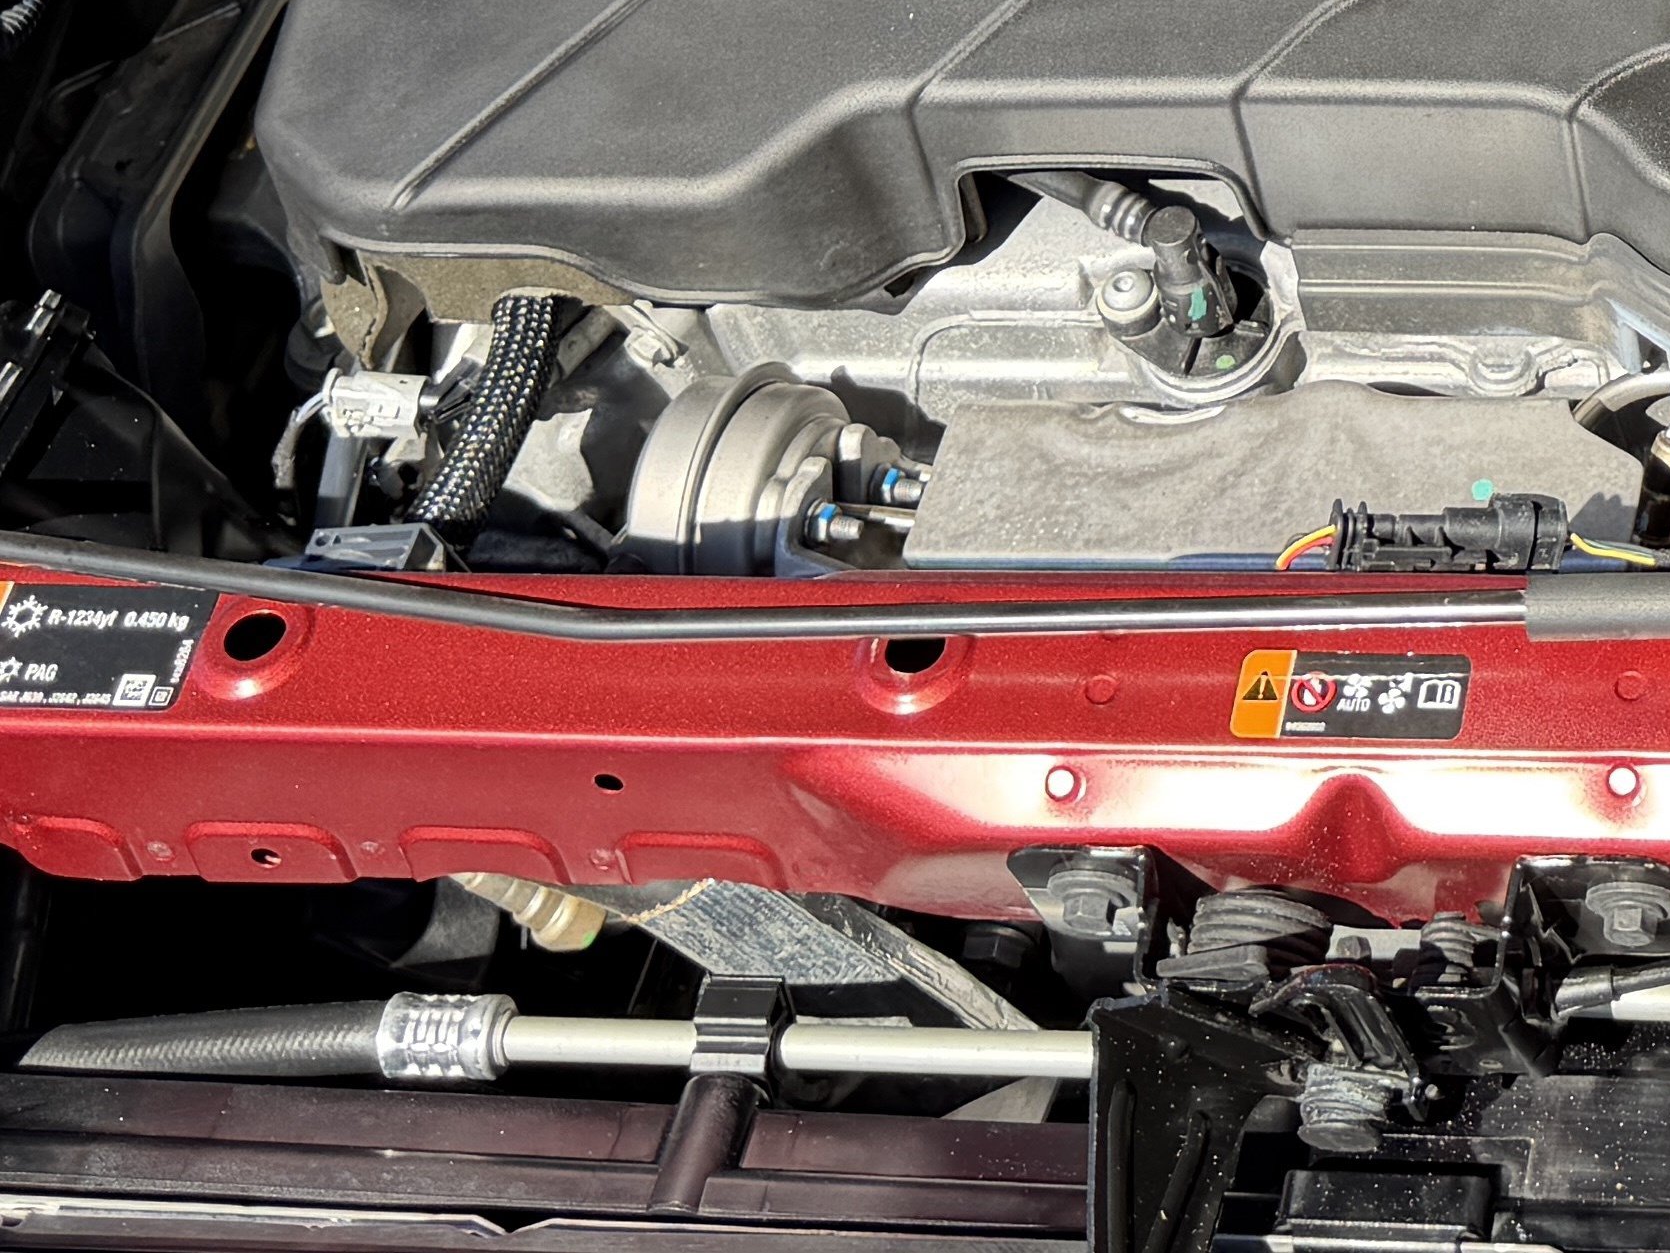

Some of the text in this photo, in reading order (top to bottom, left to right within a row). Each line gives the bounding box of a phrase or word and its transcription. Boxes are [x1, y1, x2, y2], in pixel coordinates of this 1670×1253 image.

[124, 611, 167, 628] 0.450
[167, 611, 190, 632] kg
[24, 662, 59, 682] PAG
[1336, 698, 1371, 712] AUTO
